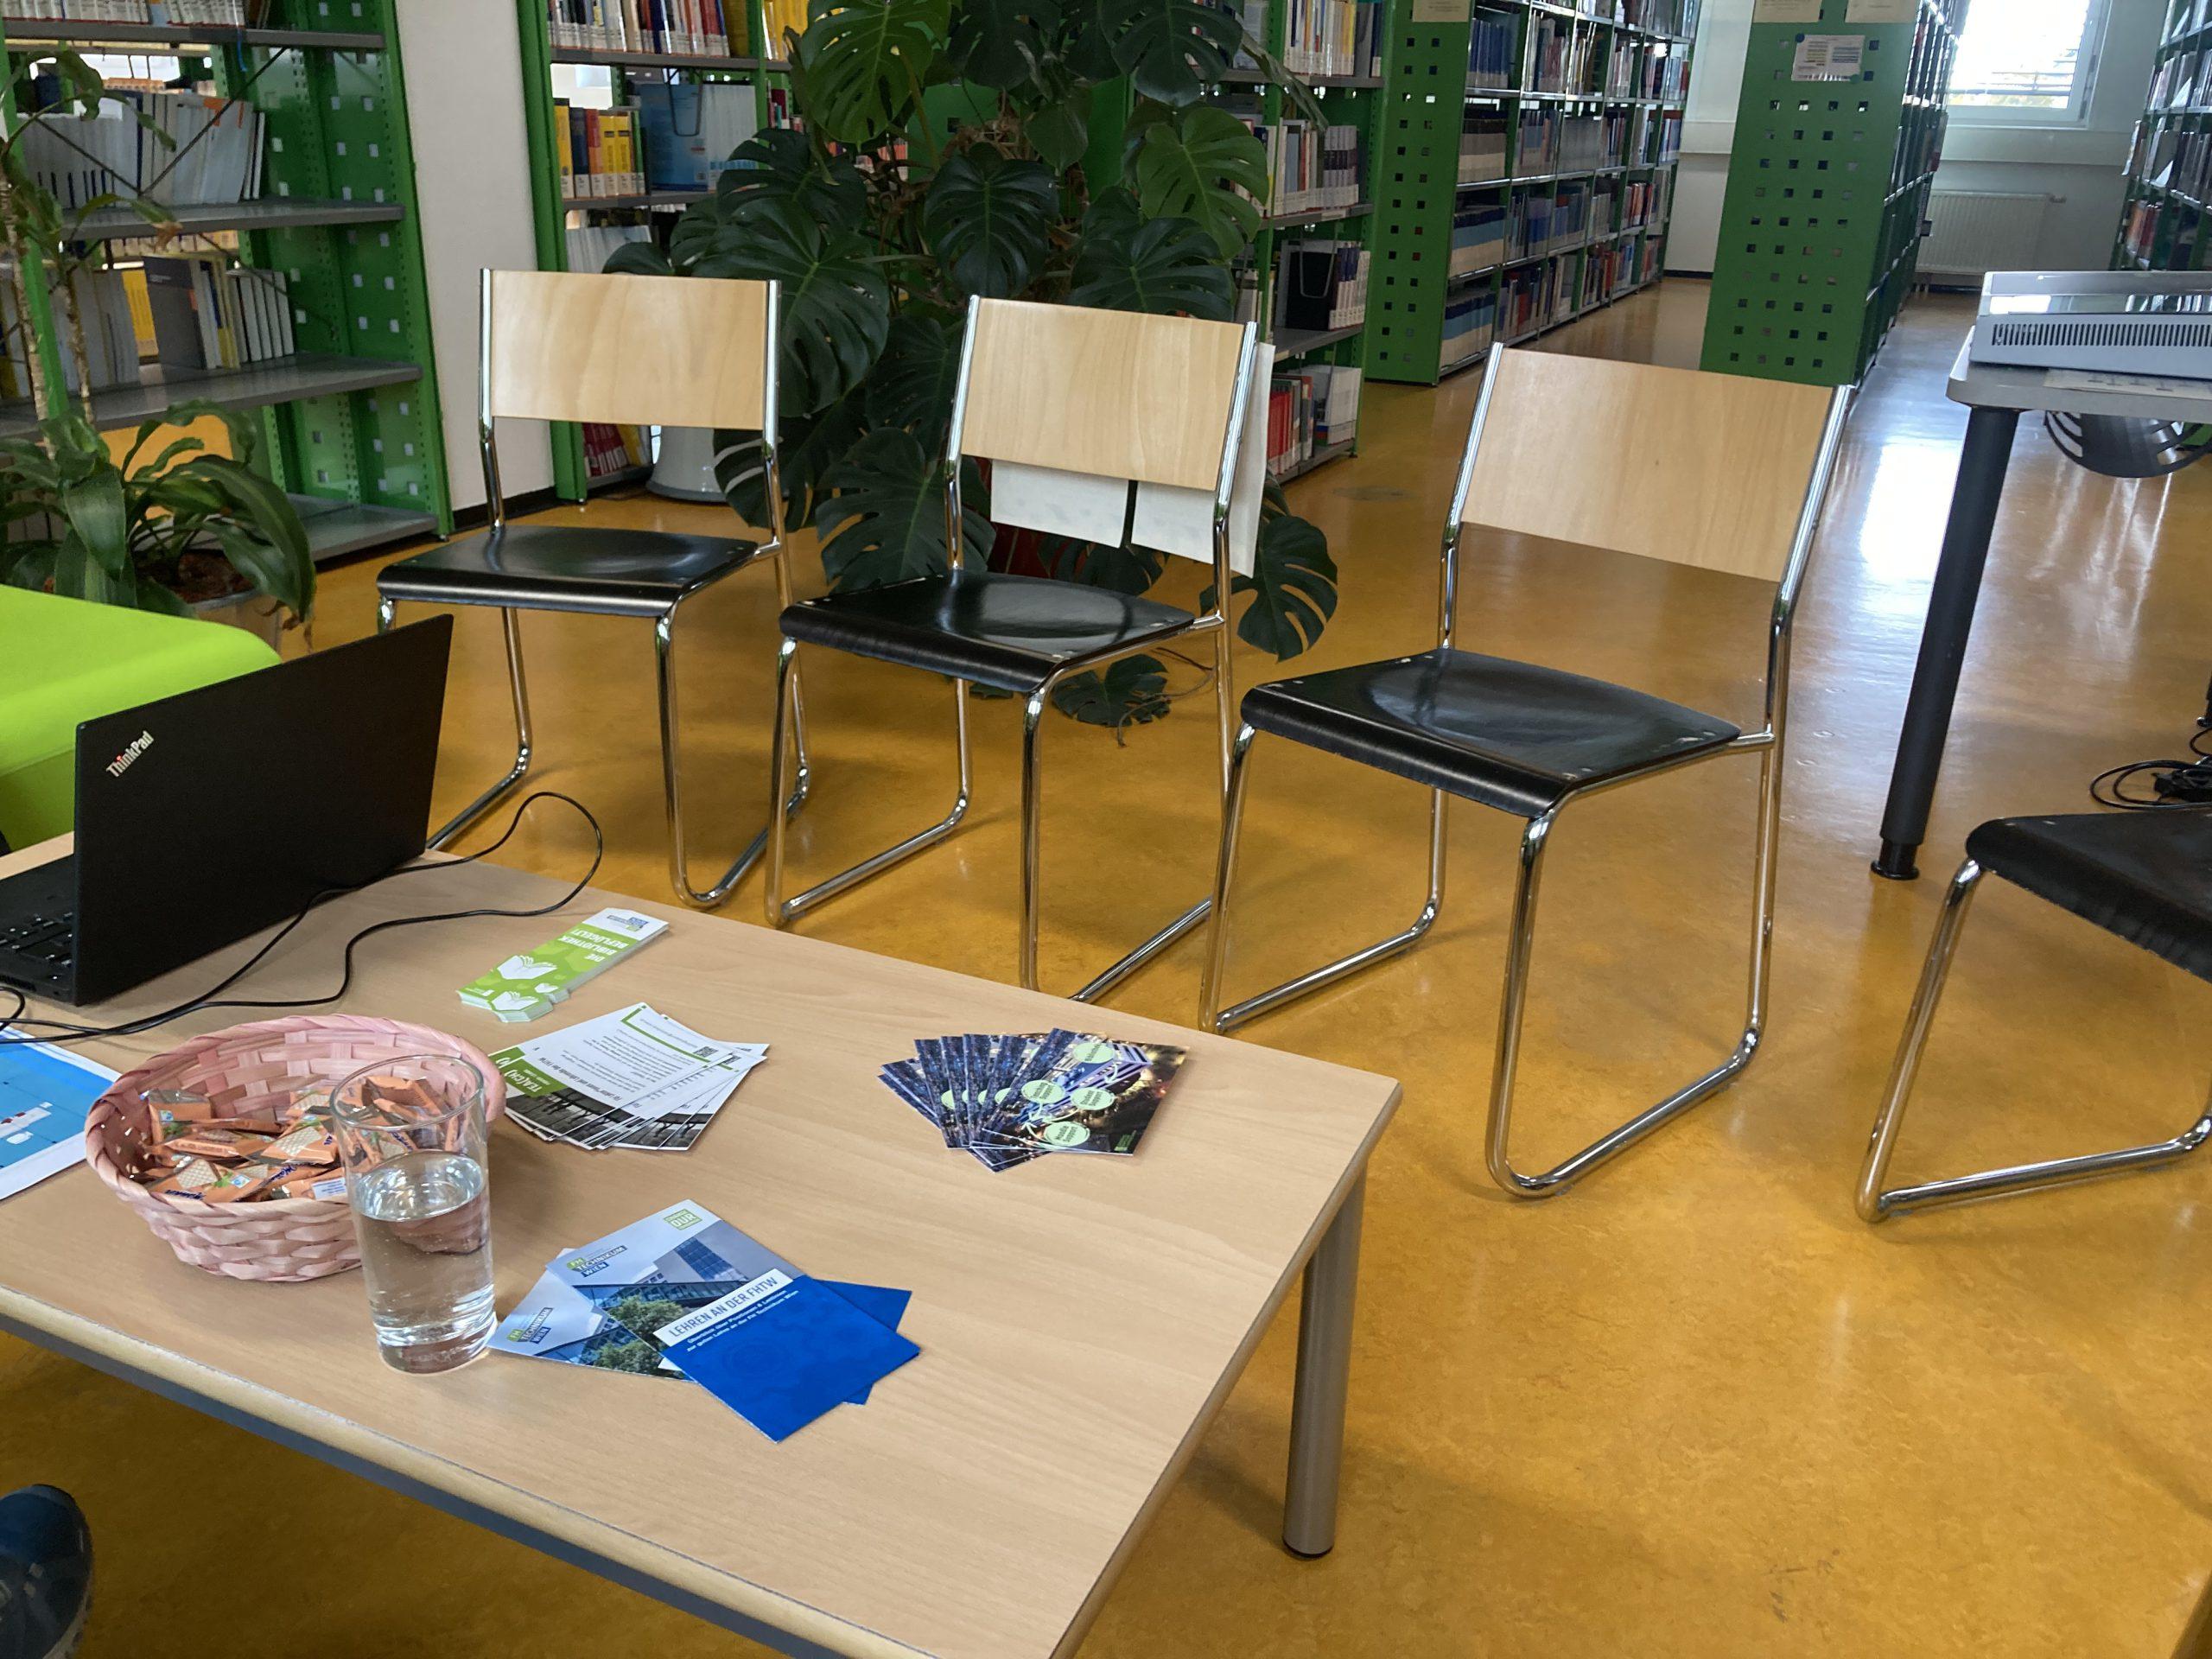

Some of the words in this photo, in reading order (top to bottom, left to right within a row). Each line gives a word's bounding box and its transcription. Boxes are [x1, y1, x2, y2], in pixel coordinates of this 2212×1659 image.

[106, 730, 154, 777] ThinkPad
[557, 935, 618, 956] BIBLIOTHEK
[584, 953, 606, 963] DIE
[504, 1069, 543, 1092] TEA(CH)
[576, 1247, 624, 1270] TECHNIKUM
[583, 1263, 607, 1276] WIEN
[669, 1312, 713, 1338] LEHREN
[710, 1304, 728, 1319] AN
[725, 1293, 751, 1310] DER
[747, 1276, 779, 1297] FHTW
